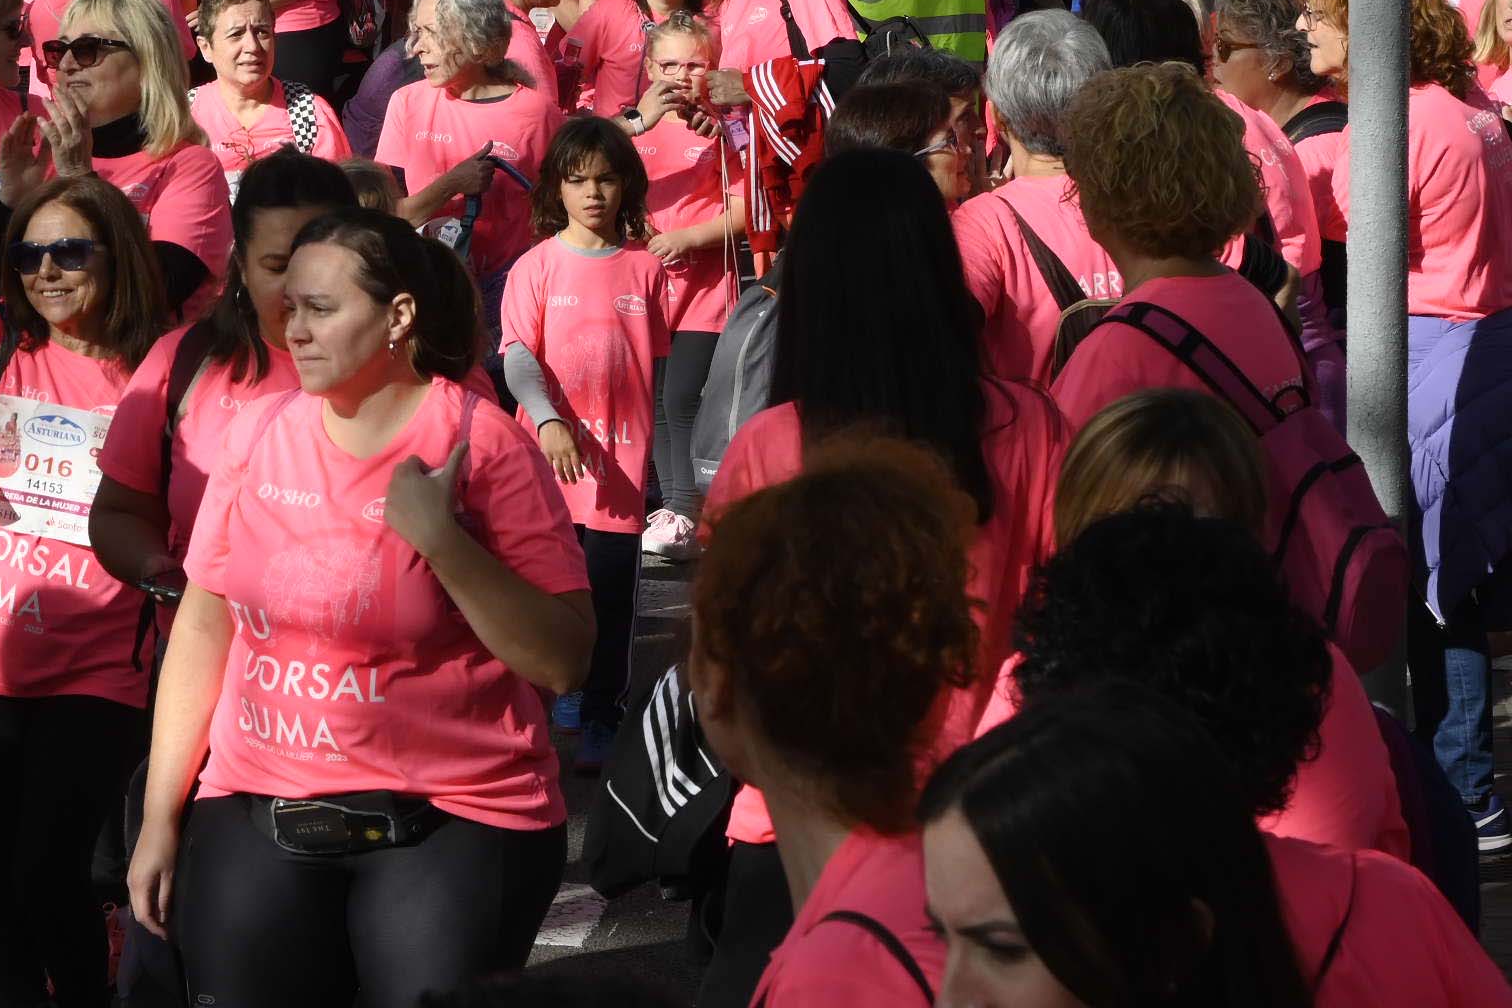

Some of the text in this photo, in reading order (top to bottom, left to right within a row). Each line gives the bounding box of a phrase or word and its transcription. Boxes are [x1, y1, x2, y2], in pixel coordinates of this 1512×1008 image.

[551, 296, 578, 307] SHO
[28, 422, 81, 442] ASTURIANA
[94, 431, 106, 439] SU
[564, 418, 633, 445] ORSAL
[25, 453, 73, 478] 016
[700, 467, 717, 475] Quec
[27, 478, 64, 495] 14153
[258, 482, 320, 509] OYSHO
[40, 498, 51, 506] LA
[52, 500, 81, 513] MUJER
[231, 600, 271, 640] TU
[244, 652, 386, 704] DORSAL
[238, 697, 340, 752] SUMA
